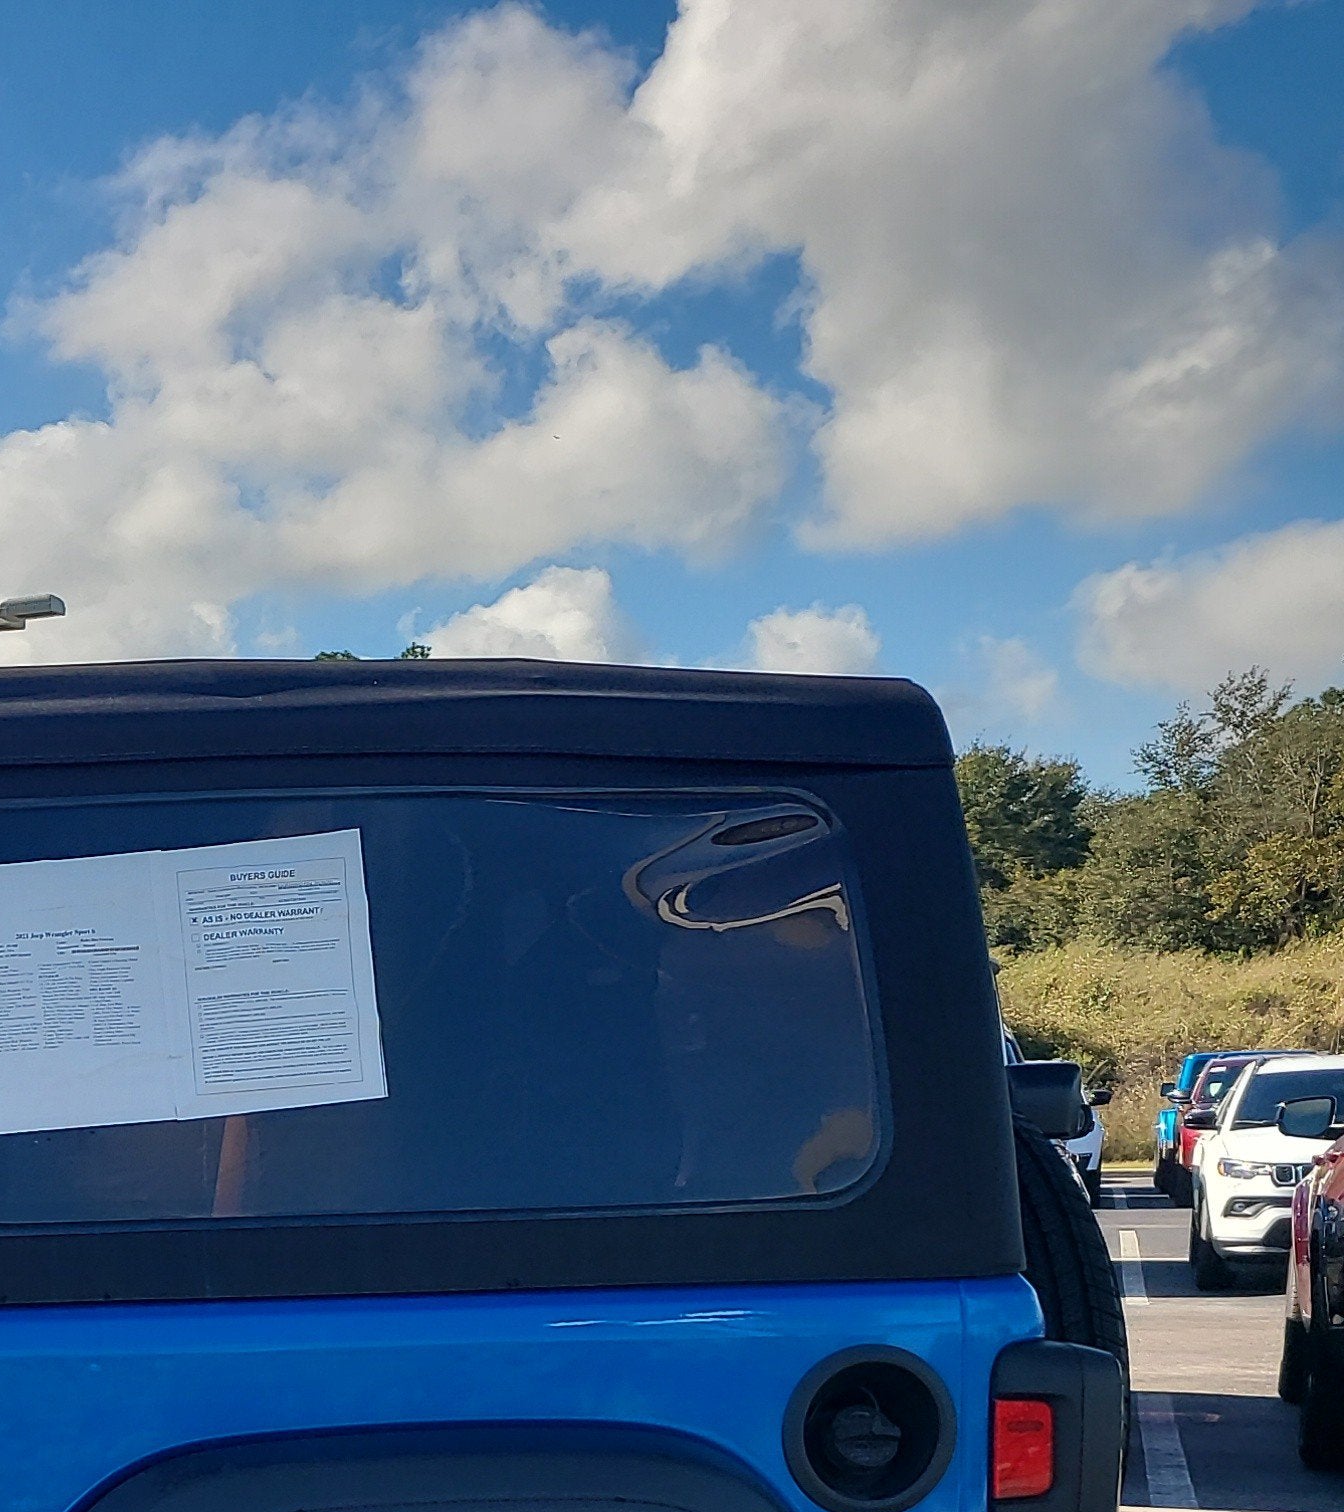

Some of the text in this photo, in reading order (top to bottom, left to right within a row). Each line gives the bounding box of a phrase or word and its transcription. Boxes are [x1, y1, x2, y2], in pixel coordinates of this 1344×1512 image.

[230, 869, 295, 882] BUYERS GUIDE
[202, 915, 213, 924] AS
[215, 914, 223, 923] IS
[230, 912, 243, 921] NO
[243, 909, 276, 920] DEALER
[203, 927, 285, 941] DEALER WARRANTY
